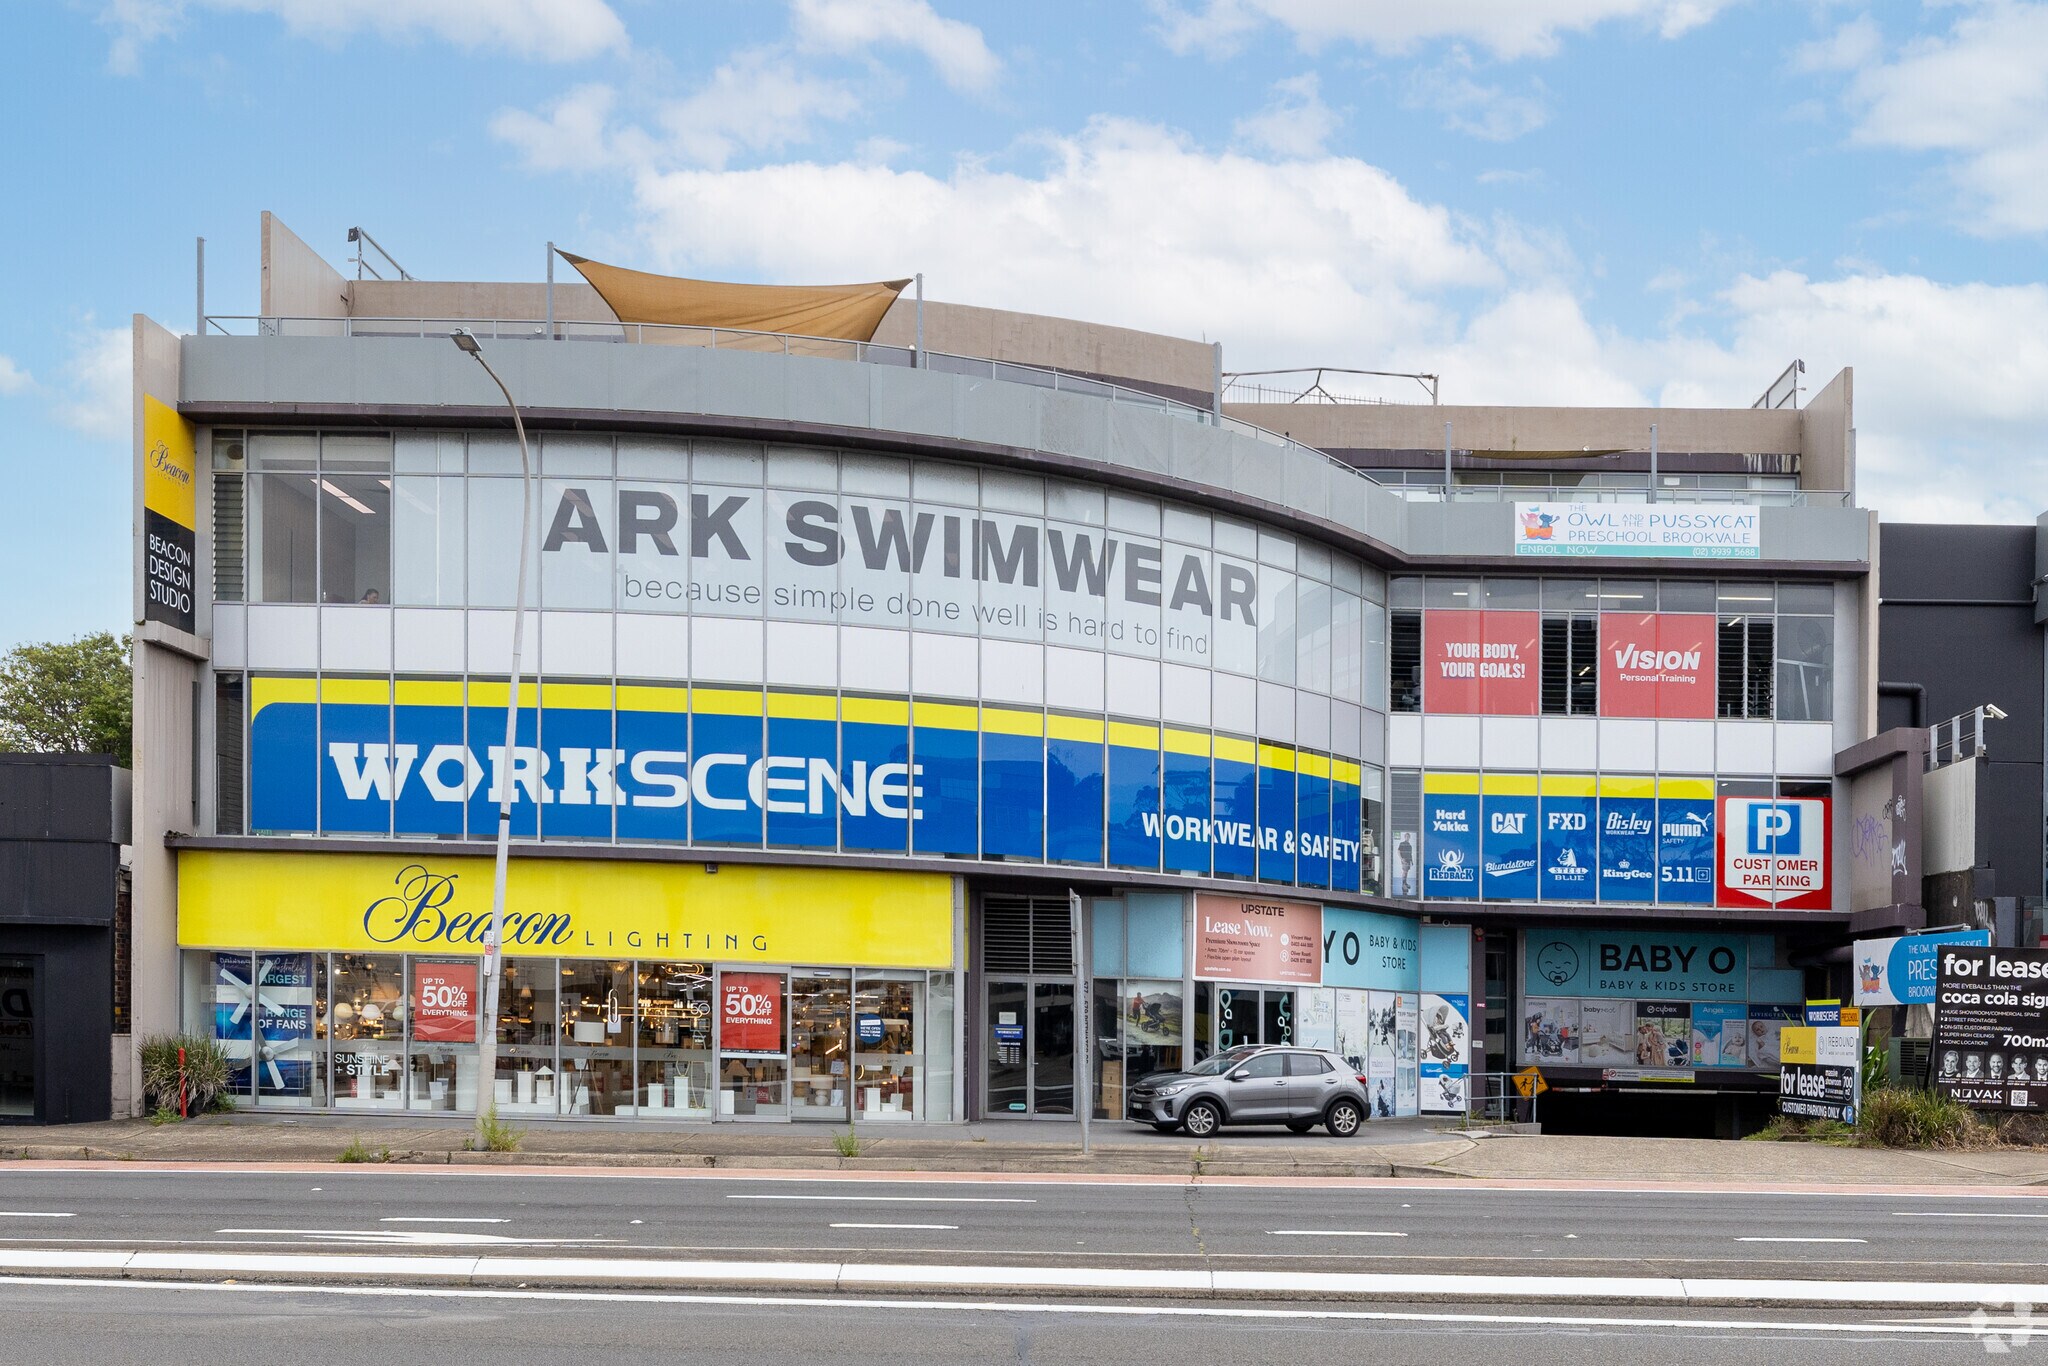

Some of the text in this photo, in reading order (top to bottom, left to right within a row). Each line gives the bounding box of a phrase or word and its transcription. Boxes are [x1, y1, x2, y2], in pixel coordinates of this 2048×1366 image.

[150, 439, 190, 484] Beacon
[1568, 512, 1619, 527] OWL
[1650, 514, 1756, 529] PUSSYCAT
[1569, 531, 1750, 543] PRESCHOOL BROOKVALE
[150, 533, 190, 568] BEACON
[542, 488, 1257, 627] ARK SWIMWEAR
[1520, 545, 1597, 555] ENROL NOW
[1693, 547, 1756, 557] (02) 9939 5688
[150, 555, 190, 590] DESIGN
[150, 579, 190, 614] STUDIO
[625, 574, 1208, 655] because simple done well is hard to find
[1445, 643, 1520, 660] YOUR BODY,
[1615, 643, 1701, 670] VISION
[1440, 662, 1526, 679] YOUR GOALS!
[1620, 673, 1696, 684] Personal Training
[329, 742, 924, 820] WORKSCENE
[1436, 809, 1466, 820] Hard
[1433, 820, 1469, 832] Yakka
[1491, 812, 1526, 834] CAT
[1606, 812, 1652, 835] Bisley
[1662, 823, 1701, 837] PUMA
[1757, 808, 1792, 851] P
[1141, 812, 1360, 863] WORKWEAR & SAFETY
[1485, 860, 1536, 872] Blundstone
[1733, 858, 1818, 871] CUSTOMER
[1431, 868, 1473, 880] REDBACK
[1603, 869, 1653, 880] KingGee
[1661, 866, 1694, 883] 5.11
[1743, 874, 1811, 887] PARKING
[363, 864, 574, 945] Beacon
[586, 930, 767, 951] LIGHTING
[1241, 903, 1285, 917] UPSTATE
[1205, 916, 1273, 938] Lease Now.
[1343, 931, 1360, 965] O
[1369, 934, 1417, 952] BABY & KIDS
[1908, 943, 1931, 954] THE OWL
[1382, 956, 1406, 970] STORE
[1600, 944, 1735, 974] BABY O
[1944, 953, 1983, 977] for
[261, 974, 306, 984] ARGEST
[434, 977, 445, 985] TO
[1600, 980, 1735, 993] BABY & KIDS STORE
[421, 985, 468, 1008] 50%
[451, 1000, 468, 1008] OFF
[1942, 991, 2048, 1009] coca cola sig
[725, 993, 772, 1016] 50%
[755, 1008, 772, 1016] OFF
[1655, 1006, 1677, 1015] cybex
[1808, 1011, 1839, 1021] WORKSCENE
[259, 1019, 307, 1029] OF FANS
[1828, 1036, 1855, 1048] REBOUND
[335, 1053, 389, 1065] SUNSHINE
[346, 1064, 389, 1076] STYLE
[1780, 1066, 1825, 1099] for lease
[1843, 1076, 1853, 1089] 700
[1782, 1101, 1840, 1119] CUSTOMER PARKING ONLY
